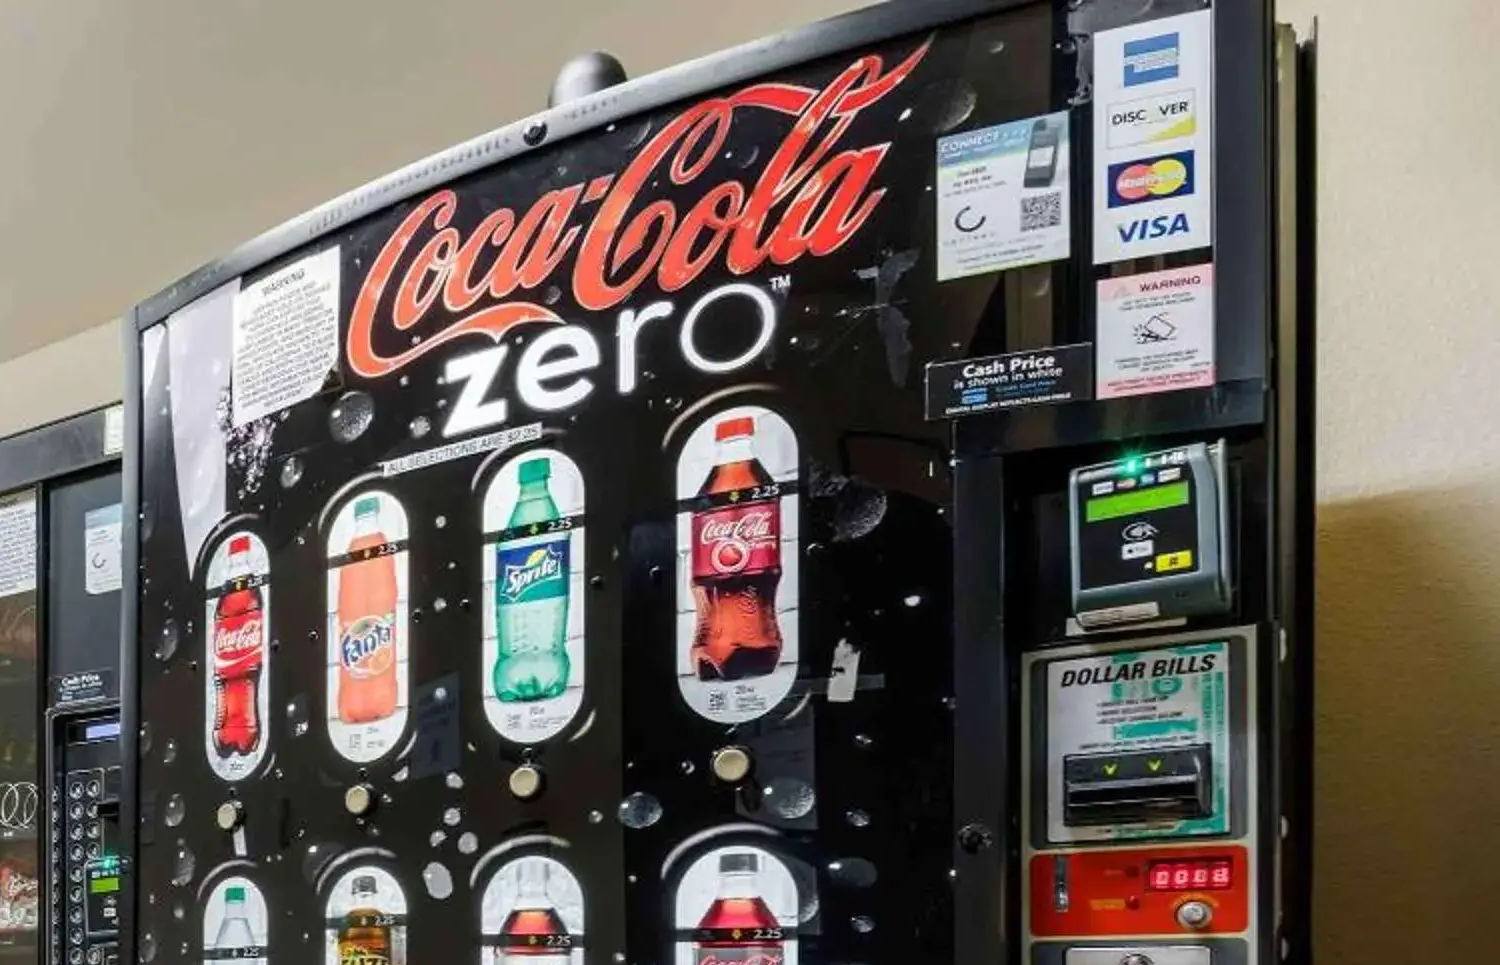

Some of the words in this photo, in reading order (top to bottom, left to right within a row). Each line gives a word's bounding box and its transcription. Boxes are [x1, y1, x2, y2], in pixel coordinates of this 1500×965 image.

[346, 34, 935, 378] Coca-Cola
[1117, 213, 1190, 244] VISA
[1140, 275, 1201, 292] WARNING
[443, 283, 777, 438] zero
[963, 360, 1005, 378] Cash
[1010, 355, 1056, 372] Price
[968, 374, 1009, 388] shown
[1012, 371, 1025, 382] in
[1027, 367, 1063, 380] white
[752, 484, 781, 499] 2.25
[548, 518, 572, 532] 2.25
[702, 511, 774, 543] Coca-Cola
[507, 557, 557, 593] Sprite
[1060, 660, 1146, 688] DOLLAR
[1152, 653, 1216, 677] BILLS
[545, 934, 572, 946] 2.25
[752, 928, 783, 940] 2.25
